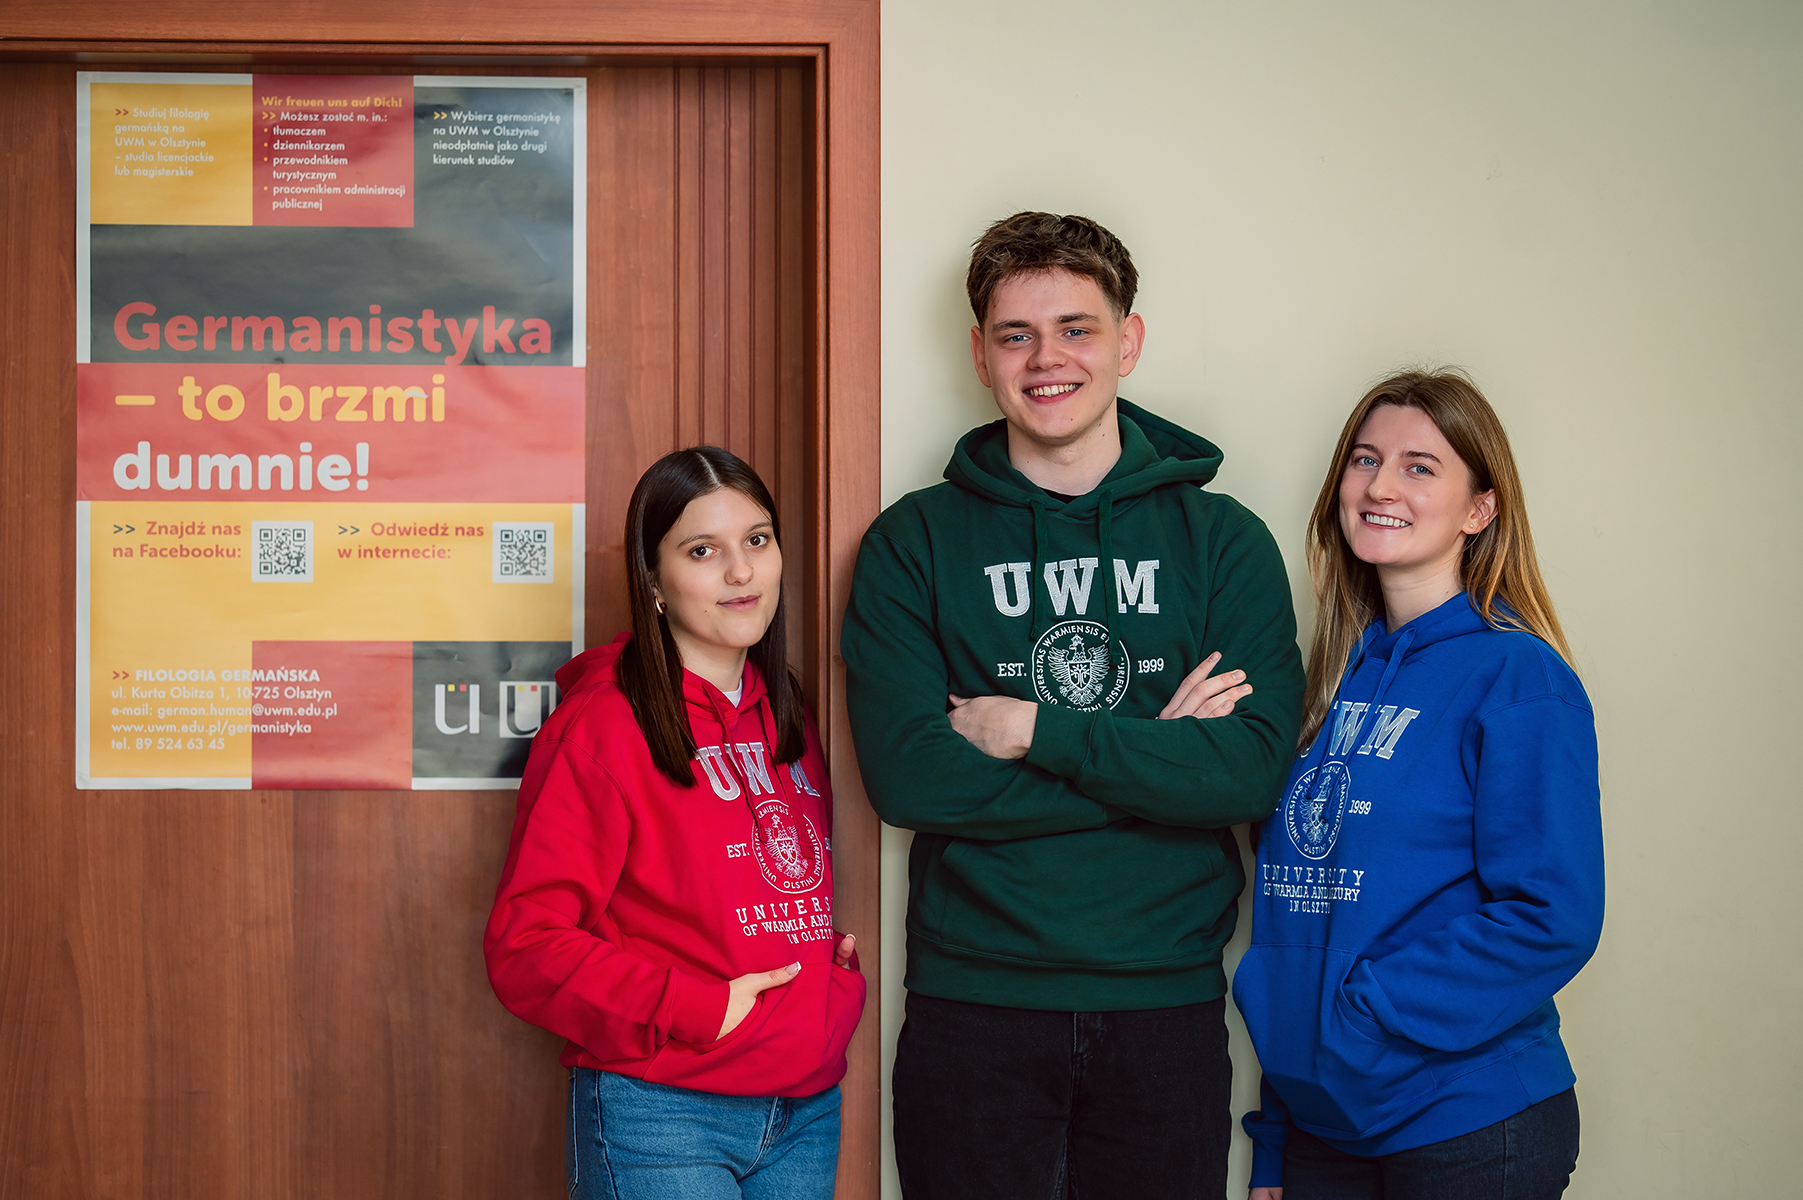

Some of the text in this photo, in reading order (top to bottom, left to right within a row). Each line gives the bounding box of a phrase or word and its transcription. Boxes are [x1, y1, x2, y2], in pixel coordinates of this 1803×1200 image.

[261, 96, 402, 108] Wir freuen uns auf Dich!
[133, 107, 210, 121] Studiuj filologię
[280, 111, 388, 122] Możesz zostać m. in.:
[450, 110, 561, 125] Wybierz germanistykę
[115, 122, 185, 135] germańską na
[272, 125, 326, 136] tłumaczem
[433, 125, 539, 139] na UWM w Olsztynie
[115, 137, 145, 147] UWM
[160, 136, 207, 150] Olsztynie
[272, 139, 346, 151] dziennikarzem
[433, 140, 548, 154] nieodpłatnie jako drugi
[125, 151, 155, 162] studia
[157, 151, 214, 164] licencjackie
[272, 154, 348, 167] przewodnikiem
[433, 154, 515, 166] kierunek studiów
[114, 165, 194, 179] lub magisterskie
[272, 170, 337, 182] turystycznym
[272, 183, 406, 198] pracownikiem administracji
[272, 198, 323, 211] publicznej
[113, 301, 552, 367] Germanistyka
[178, 376, 246, 422] to
[267, 372, 446, 423] brzmi
[112, 440, 370, 492] dumnie!
[146, 521, 242, 539] Znajdź nas
[371, 522, 485, 537] Odwiedź nas
[112, 544, 242, 559] na Facebooku:
[337, 545, 451, 559] w internecie:
[984, 557, 1160, 617] UWM
[1042, 625, 1100, 648] WARMIENSIS
[997, 662, 1027, 677] EST.
[1137, 657, 1165, 674] 1999
[135, 666, 321, 682] FILOLOGIA GERMAŃSKA
[111, 686, 332, 702] ul. Kurta Obitza 1, 10-725 Olsztyn
[111, 703, 338, 719] e-mail: german.human@uwm.edu.pl
[111, 720, 312, 736] www.uwm.edu.pl/germanistyka
[1301, 700, 1421, 760] WM
[111, 738, 225, 750] tel. 89 524 63 45
[1348, 800, 1372, 815] 1999
[727, 842, 750, 858] EST.
[783, 876, 816, 889] OLSTINI
[1272, 884, 1309, 898] WARMIA
[1289, 900, 1299, 912] IN
[742, 923, 758, 937] OF
[761, 918, 808, 933] WARMIA
[810, 914, 829, 928] AND
[787, 933, 800, 944] IN
